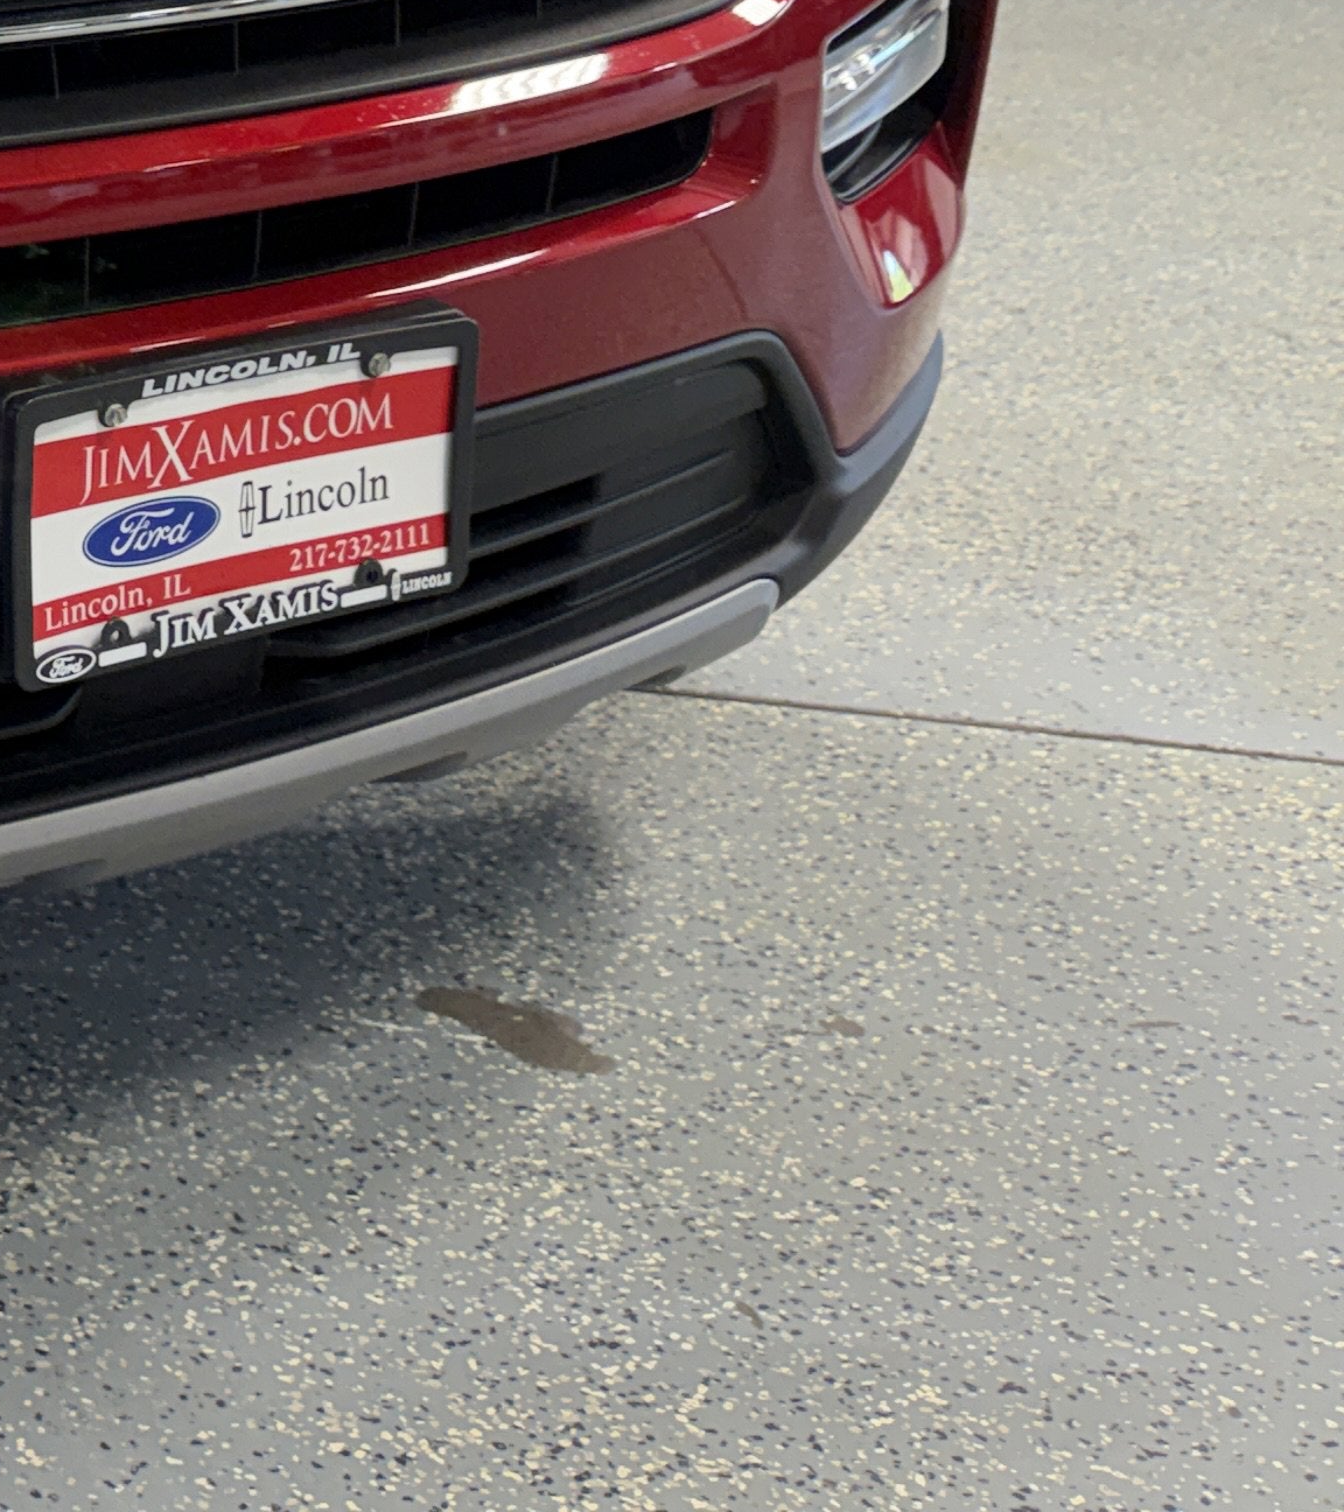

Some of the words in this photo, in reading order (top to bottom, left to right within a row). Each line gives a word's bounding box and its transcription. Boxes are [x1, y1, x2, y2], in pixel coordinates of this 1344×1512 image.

[140, 349, 314, 399] LINCOLN,
[327, 341, 361, 364] IL
[258, 466, 390, 525] Lincoln
[110, 506, 195, 557] Ford
[288, 523, 430, 573] 217-732-2111
[43, 584, 153, 632] Lincoln,
[163, 573, 192, 599] IL
[401, 571, 453, 594] LINCOLN
[153, 610, 217, 658] JIM
[224, 581, 339, 636] XAMIS
[49, 655, 84, 679] Ford
